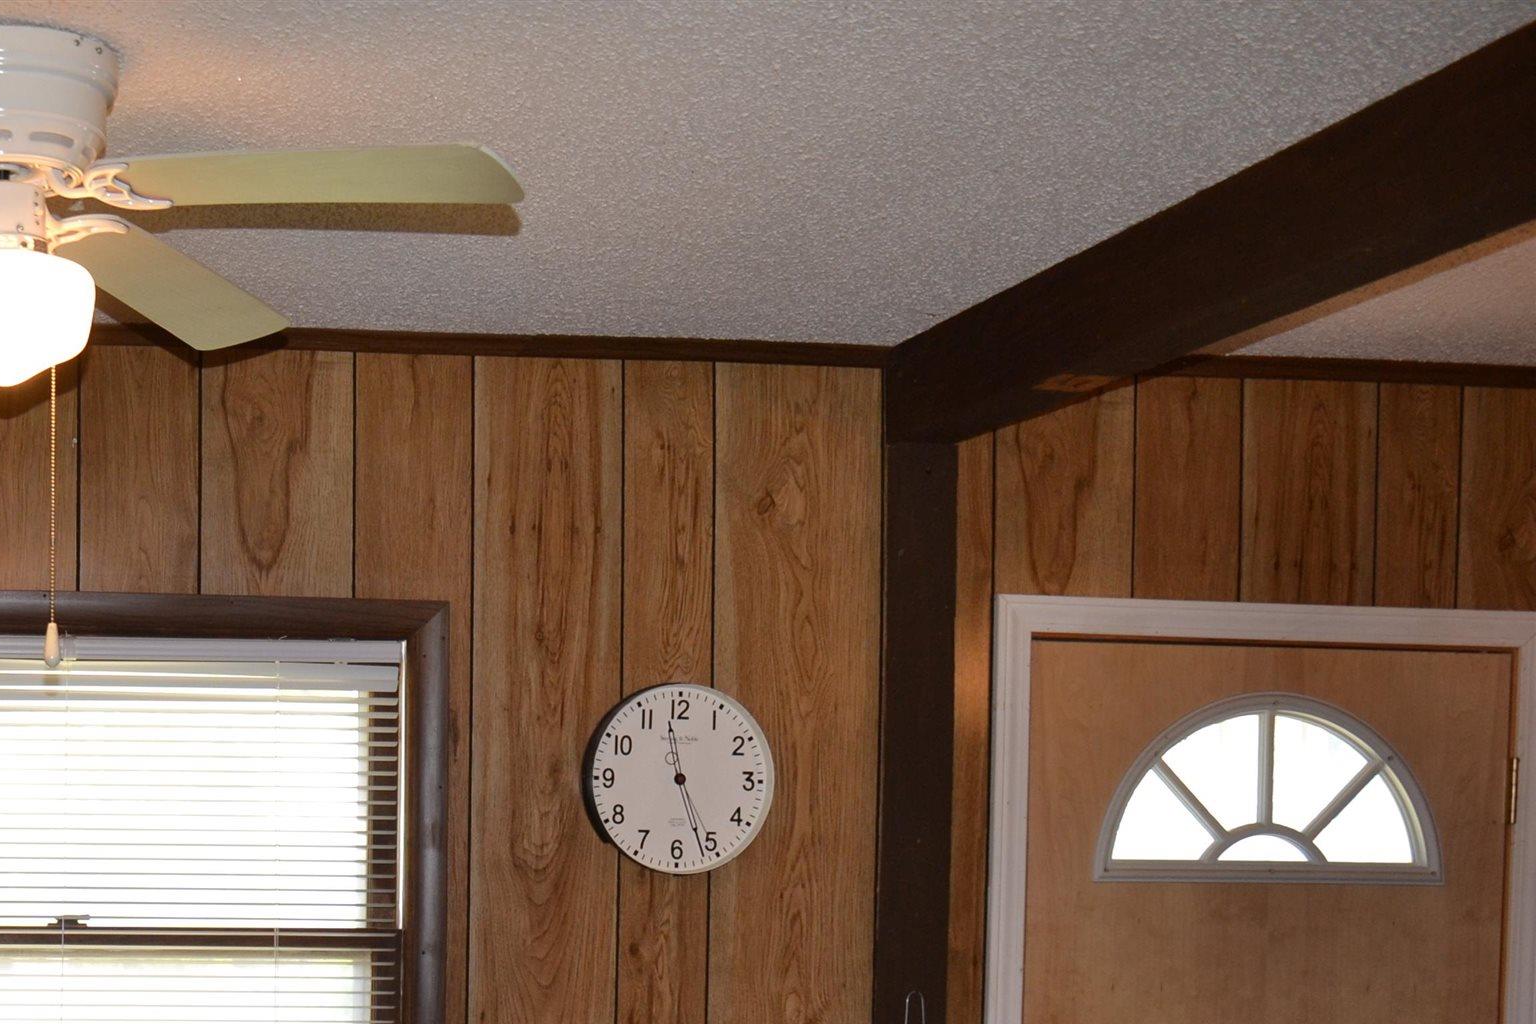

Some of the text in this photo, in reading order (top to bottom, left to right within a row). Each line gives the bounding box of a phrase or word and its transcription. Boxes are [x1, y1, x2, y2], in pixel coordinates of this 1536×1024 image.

[641, 709, 653, 730] 11
[671, 699, 690, 720] 12
[712, 710, 717, 731] 1
[614, 735, 633, 756] 10
[731, 736, 745, 756] 2
[602, 768, 615, 789] 9
[742, 771, 755, 791] 3
[612, 804, 625, 824] 8
[730, 806, 743, 826] 4
[638, 829, 650, 849] 7
[704, 832, 717, 851] 5
[670, 840, 683, 860] 6
